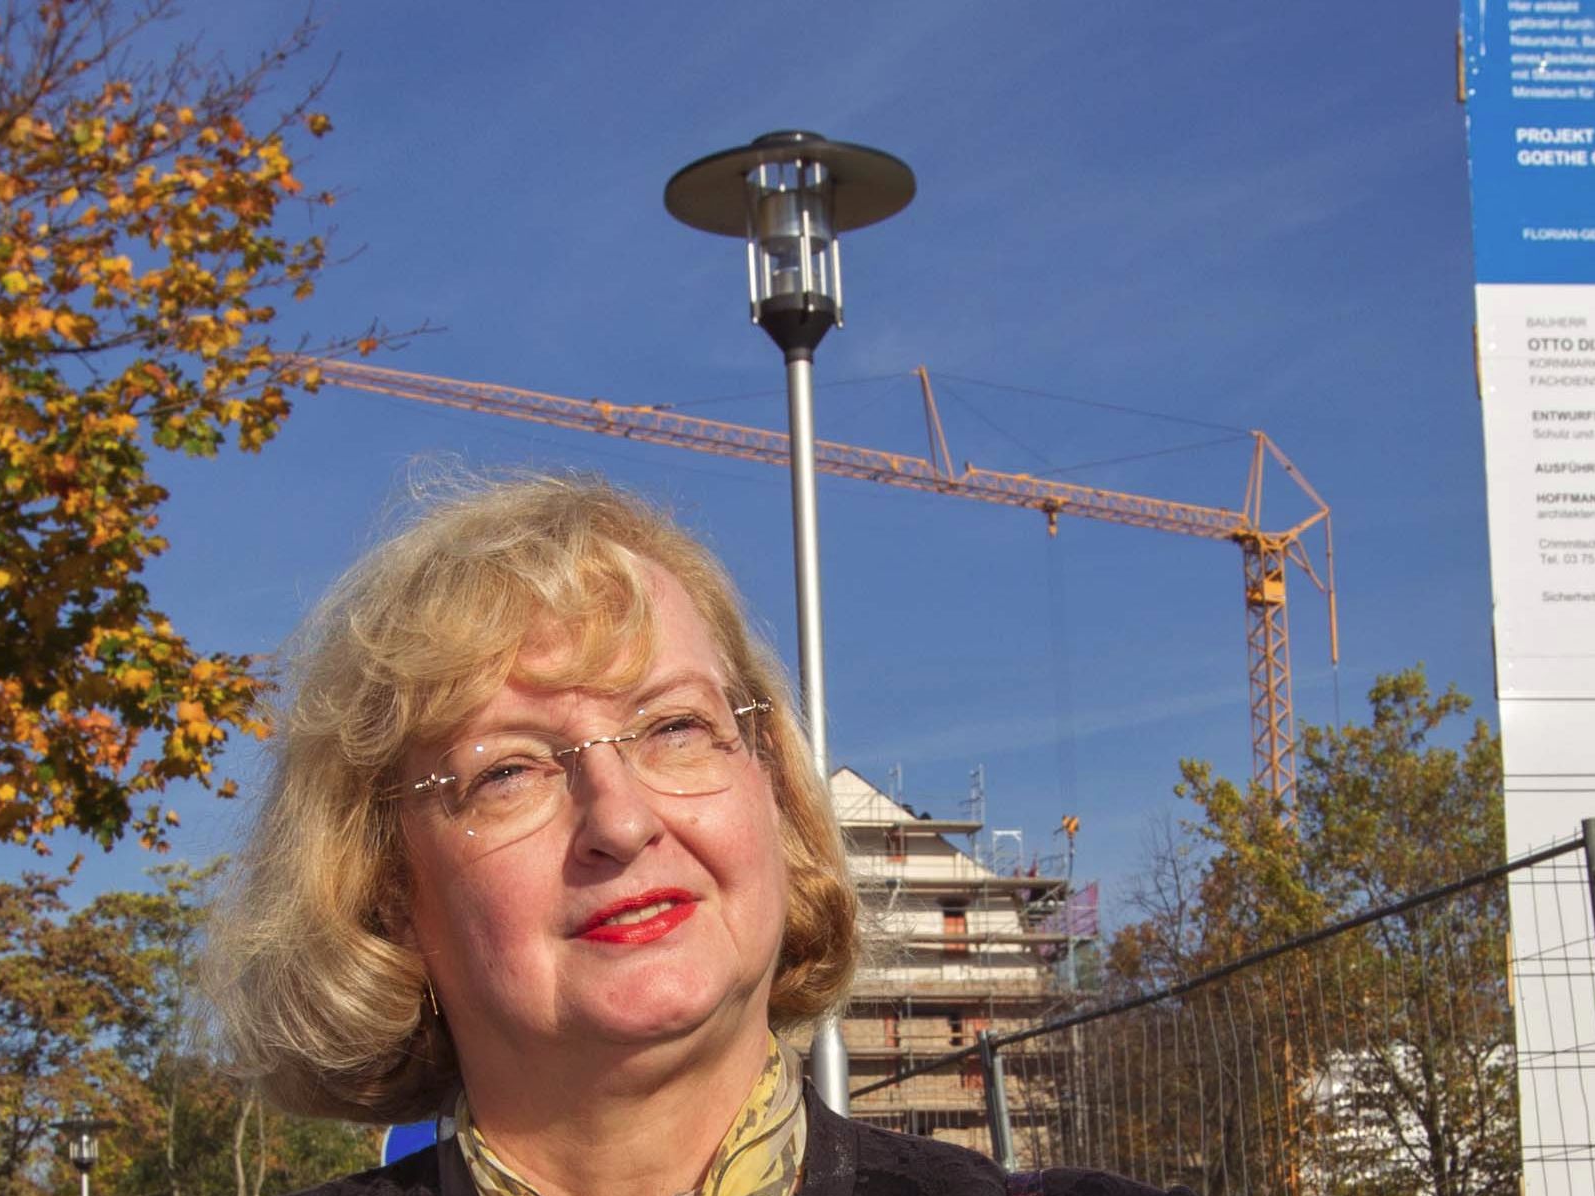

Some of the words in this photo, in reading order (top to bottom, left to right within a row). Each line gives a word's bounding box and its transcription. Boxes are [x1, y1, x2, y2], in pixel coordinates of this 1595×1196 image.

[1515, 127, 1595, 144] PROJEKT
[1516, 149, 1588, 166] GOETHE
[1526, 317, 1587, 329] BAUHERR
[1527, 337, 1574, 352] OTTO
[1572, 429, 1595, 440] und
[1540, 552, 1559, 565] Tel.
